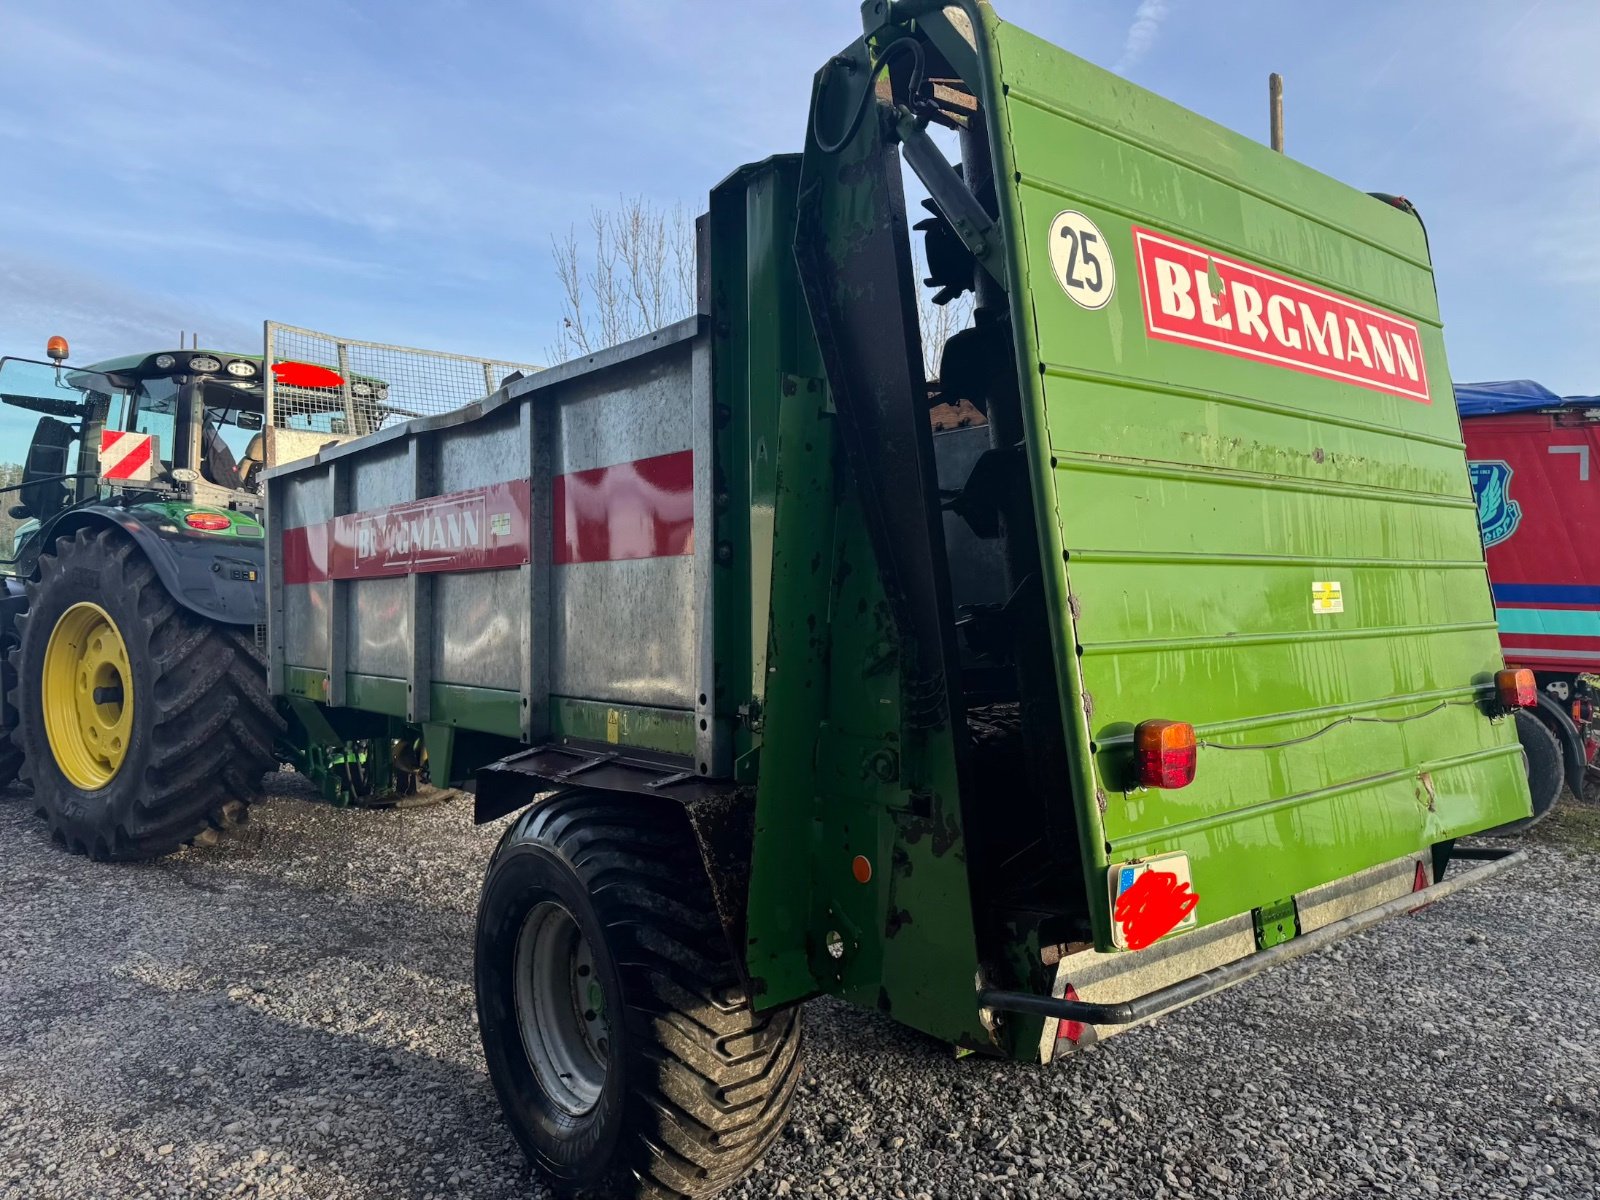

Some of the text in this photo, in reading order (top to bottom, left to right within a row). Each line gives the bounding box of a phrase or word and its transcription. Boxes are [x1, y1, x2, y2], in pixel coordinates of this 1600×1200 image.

[1061, 226, 1102, 293] 25
[1154, 257, 1420, 382] BERGMANN
[358, 509, 479, 559] BGMANN
